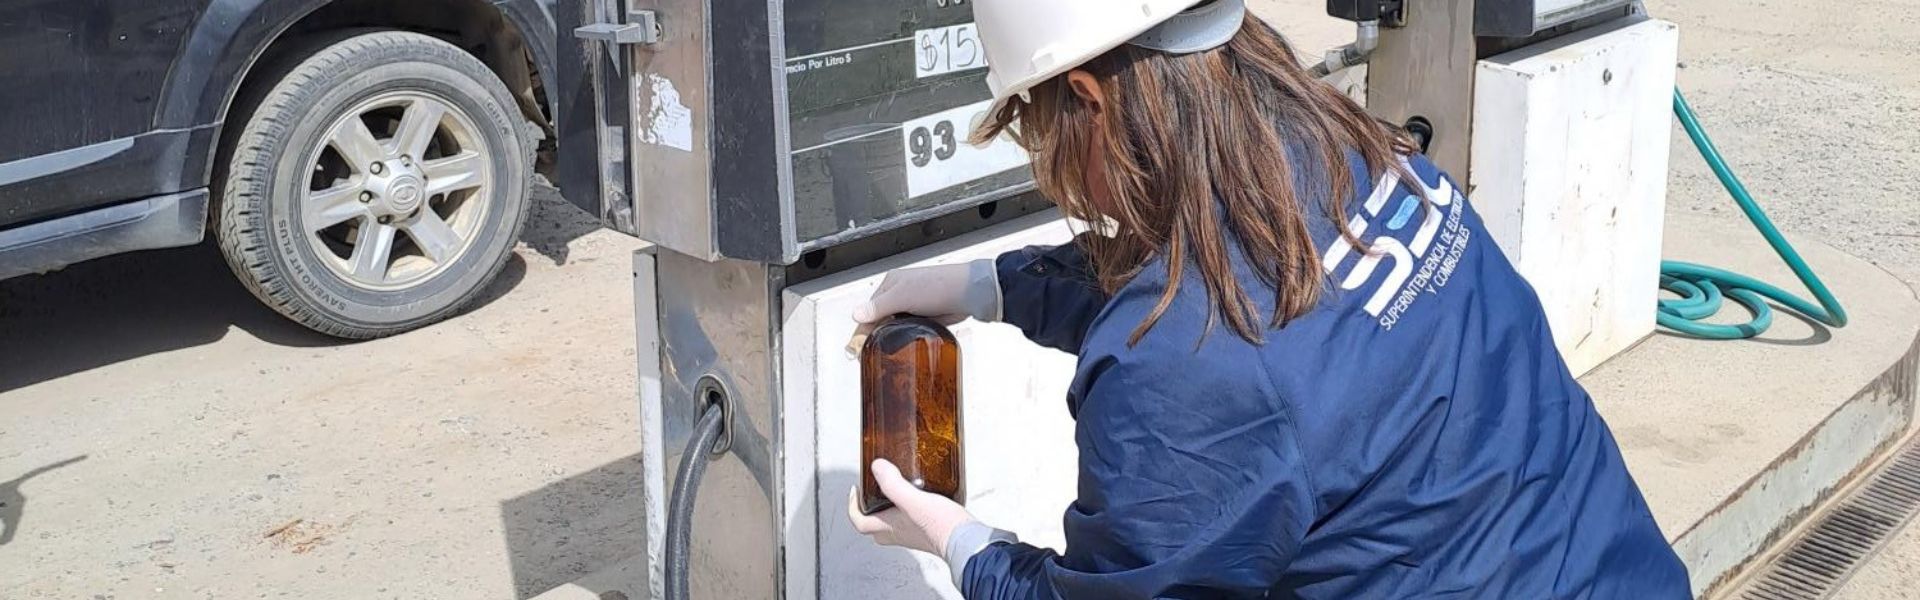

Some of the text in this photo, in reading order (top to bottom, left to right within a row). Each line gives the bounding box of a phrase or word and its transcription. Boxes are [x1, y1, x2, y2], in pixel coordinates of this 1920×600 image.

[785, 53, 852, 74] recio Por Litro $
[920, 27, 986, 72] $15
[909, 120, 956, 167] 93
[279, 219, 347, 311] SAVERO HT PLUS
[1380, 242, 1447, 330] SUPERINTENDENCIA
[1440, 228, 1454, 244] DE
[1426, 224, 1470, 295] Y COMBUSTIBLES
